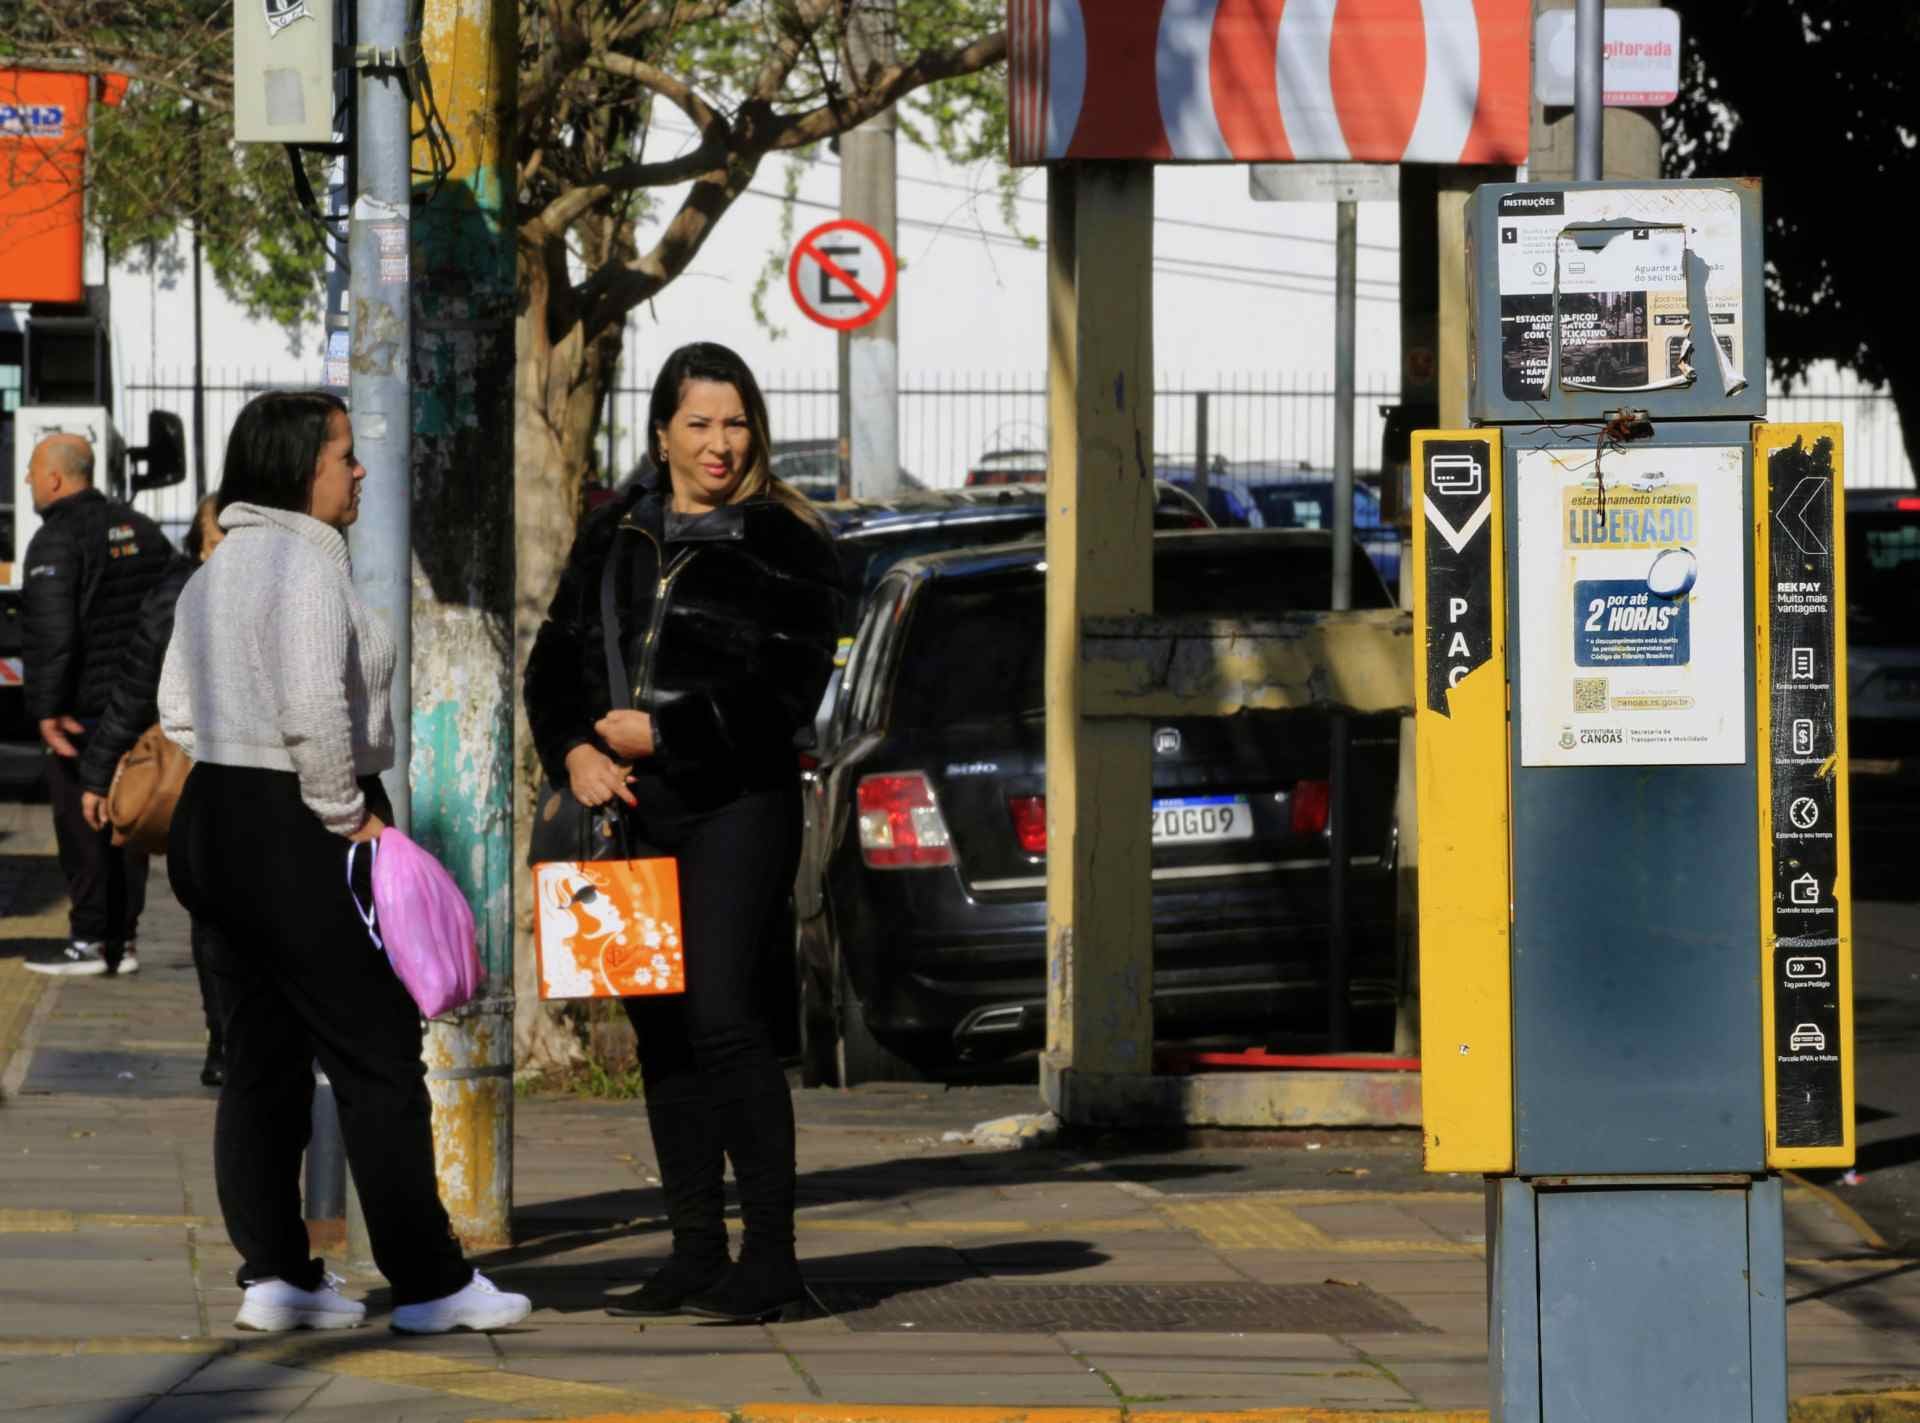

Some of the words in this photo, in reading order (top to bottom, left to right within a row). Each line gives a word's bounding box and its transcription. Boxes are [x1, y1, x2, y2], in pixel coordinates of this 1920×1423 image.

[1504, 197, 1556, 208] INSTRUÇÕES
[1635, 264, 1670, 275] Aguarde
[1635, 272, 1646, 281] do
[1648, 273, 1662, 281] seu
[1573, 313, 1598, 321] FICOU
[1524, 330, 1544, 339] COM
[1653, 493, 1692, 505] rotativo
[1570, 508, 1695, 544] LIBERADO
[1777, 582, 1798, 593] REK
[1799, 582, 1821, 593] PAY
[1607, 594, 1628, 608] por
[1629, 592, 1648, 605] até
[1777, 593, 1804, 603] Muito
[1806, 594, 1828, 603] mais
[1584, 598, 1606, 632] 2
[1777, 604, 1828, 615] vantagens.
[1580, 734, 1623, 744] CANOAS
[1784, 981, 1794, 989] Tag
